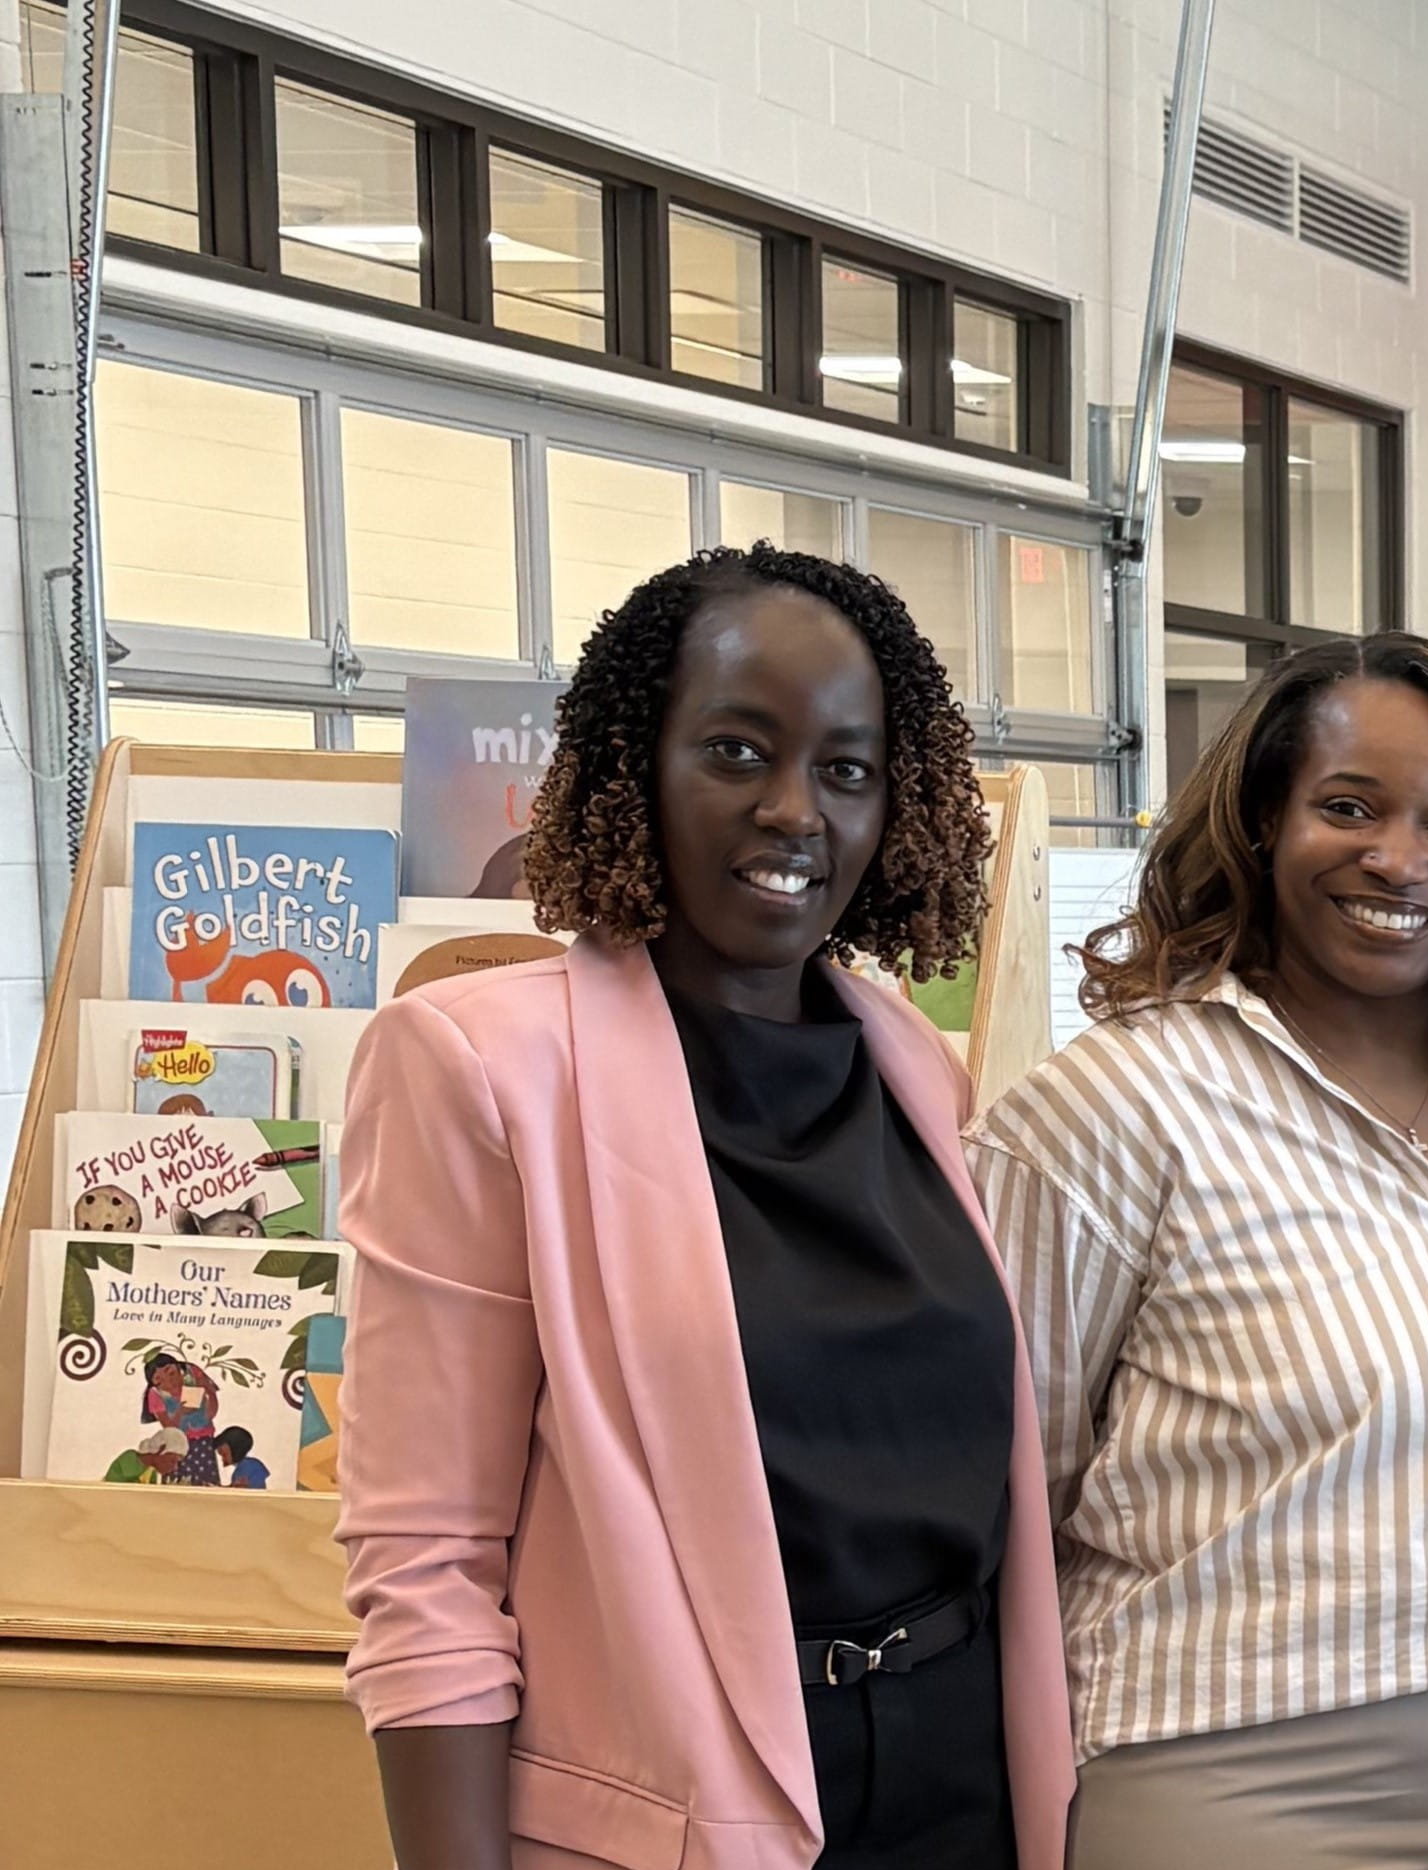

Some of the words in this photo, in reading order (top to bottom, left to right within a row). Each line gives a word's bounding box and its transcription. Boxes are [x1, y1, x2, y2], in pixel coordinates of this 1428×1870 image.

[472, 712, 559, 766] mix
[154, 834, 353, 905] Gilbert
[155, 891, 371, 963] Goldfish
[157, 1051, 211, 1079] Hello
[76, 1157, 101, 1188] IF
[104, 1140, 146, 1176] YOU
[150, 1124, 203, 1160] GIVE
[141, 1174, 155, 1198] A
[158, 1142, 233, 1188] MOUSE
[154, 1196, 168, 1219] A
[176, 1162, 256, 1210] COOKIE
[106, 1281, 209, 1308] Mothers'
[211, 1286, 292, 1312] Names
[180, 1259, 226, 1283] Our
[113, 1308, 145, 1322] Love
[149, 1311, 163, 1323] in
[166, 1311, 206, 1327] Many
[210, 1313, 282, 1329] Languages
